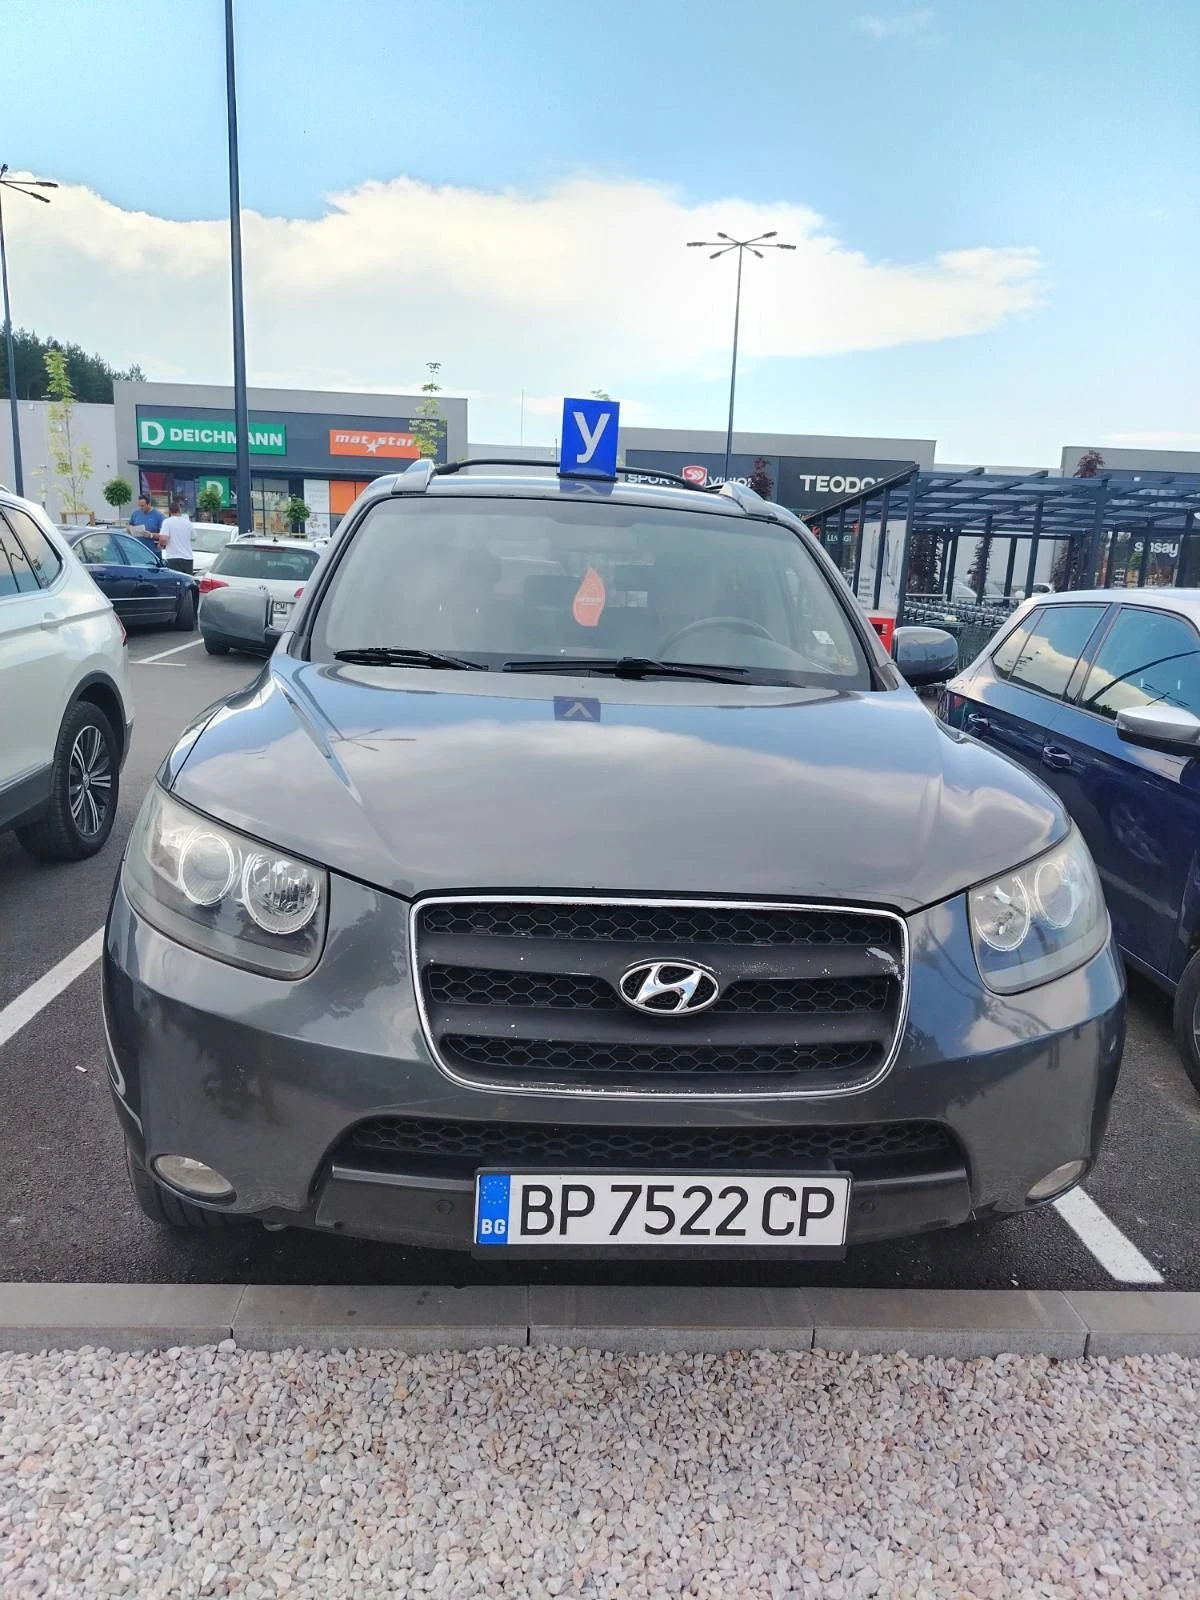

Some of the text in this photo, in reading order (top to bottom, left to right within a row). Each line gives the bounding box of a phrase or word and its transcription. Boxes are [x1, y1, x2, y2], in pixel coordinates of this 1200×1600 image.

[335, 434, 368, 444] mat
[627, 474, 677, 485] SPOR
[799, 474, 886, 494] TEODO
[1133, 541, 1179, 558] snsay
[519, 1184, 835, 1237] BP 7522 CP
[481, 1218, 507, 1236] BG
